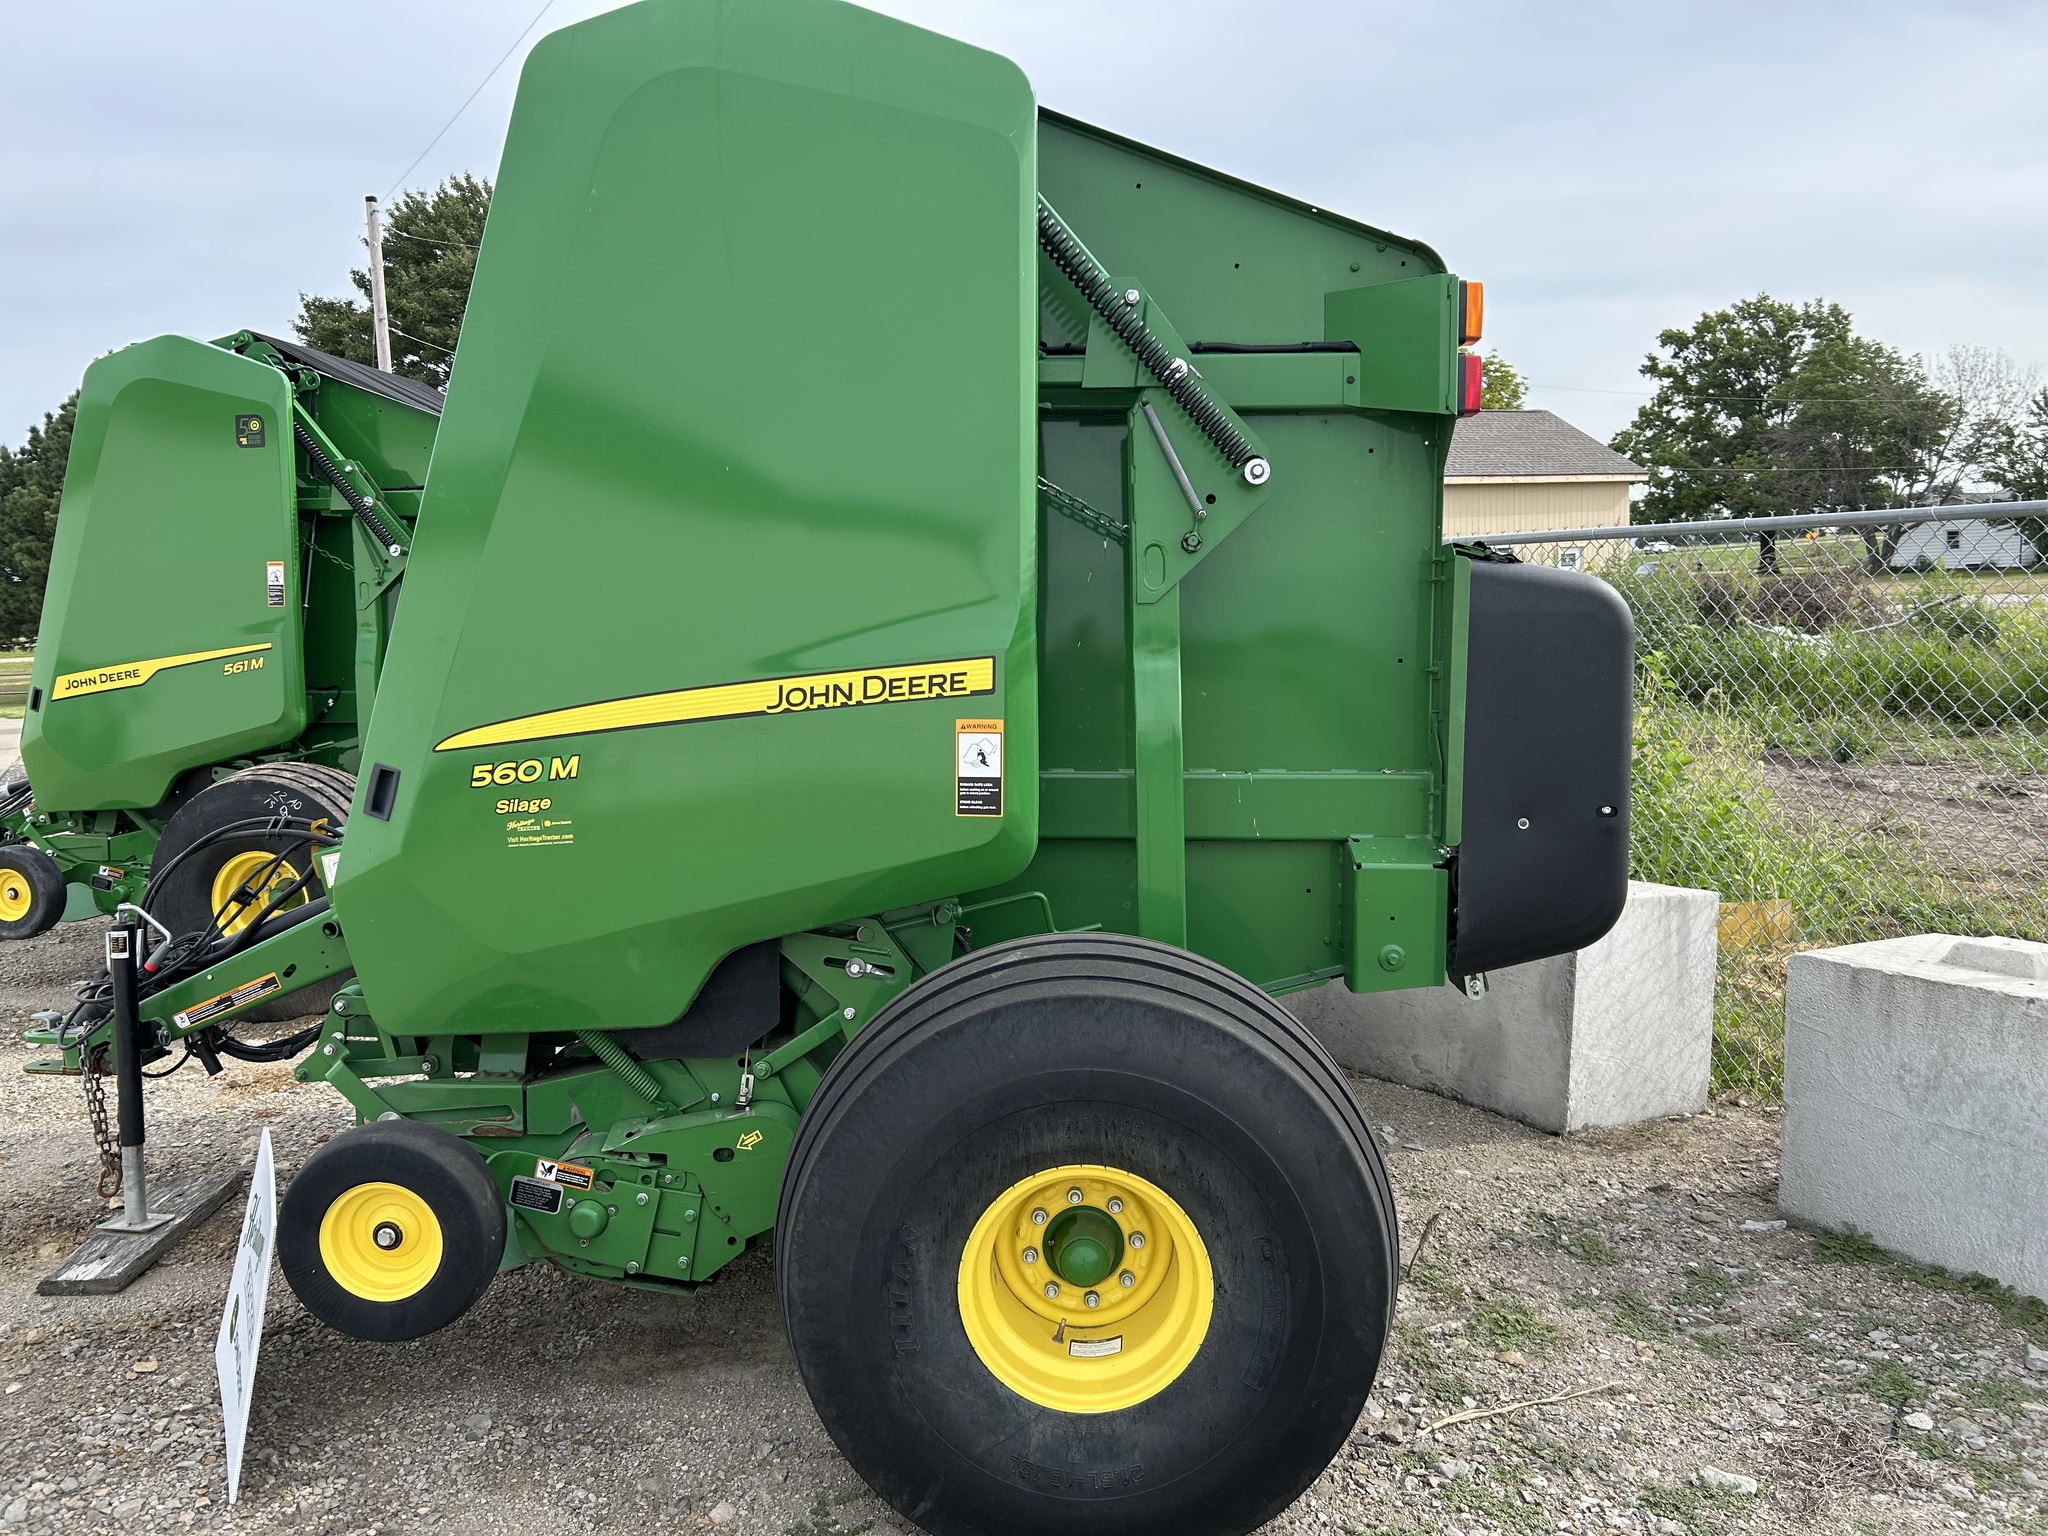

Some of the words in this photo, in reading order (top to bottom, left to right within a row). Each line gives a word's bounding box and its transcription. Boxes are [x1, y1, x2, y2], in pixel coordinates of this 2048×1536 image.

[223, 659, 249, 676] 561
[250, 656, 264, 670] M
[64, 675, 97, 690] JOHN
[99, 668, 141, 684] DEERE
[766, 675, 853, 712] JOHN
[861, 672, 969, 701] DEERE
[470, 758, 544, 788] 560
[546, 754, 580, 780] M
[495, 797, 552, 815] Silage
[520, 834, 574, 842] HeritageTractor.com
[887, 1222, 925, 1359] TITAN
